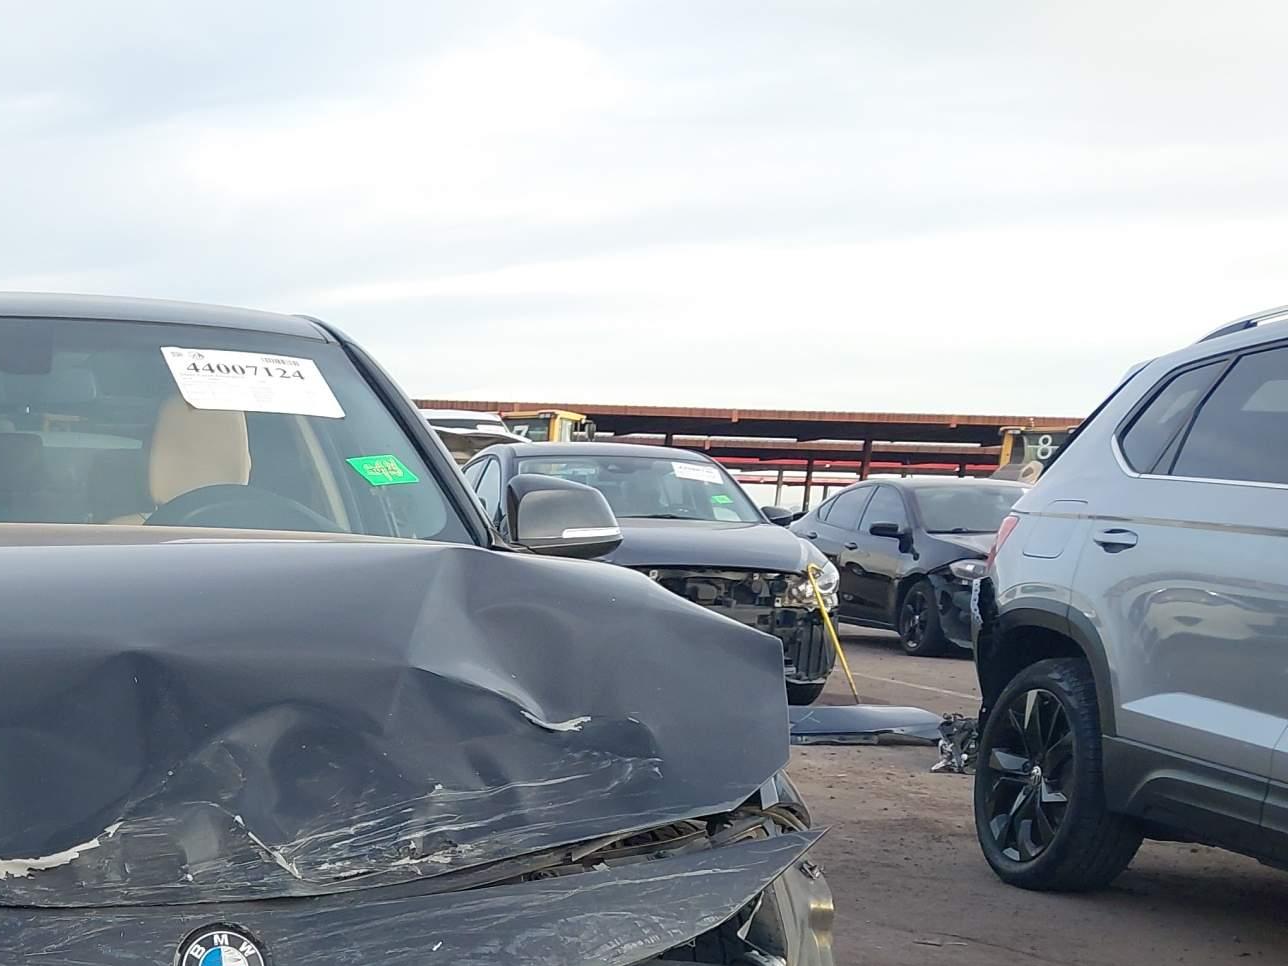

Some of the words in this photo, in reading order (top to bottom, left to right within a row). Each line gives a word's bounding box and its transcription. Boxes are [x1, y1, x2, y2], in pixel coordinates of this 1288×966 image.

[186, 362, 304, 380] 44007124
[1037, 435, 1052, 459] 8
[189, 933, 256, 960] BMW
